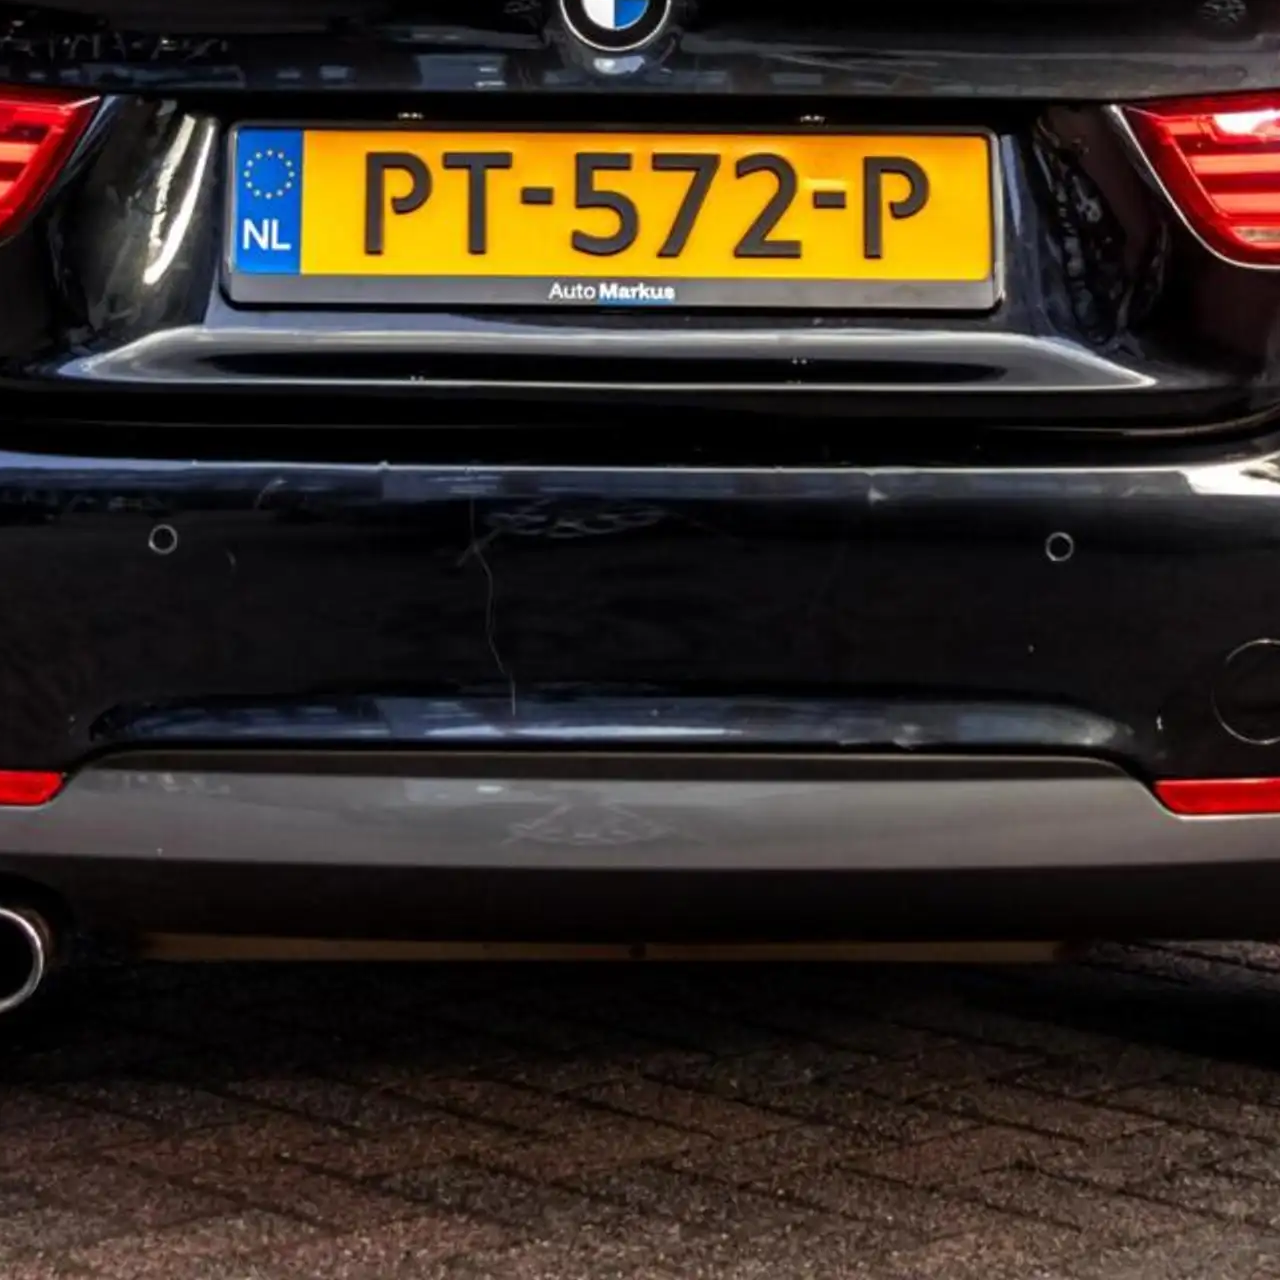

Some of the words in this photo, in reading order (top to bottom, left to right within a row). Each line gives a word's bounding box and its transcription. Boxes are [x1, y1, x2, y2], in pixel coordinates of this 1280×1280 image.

[364, 151, 930, 259] PT-572-P
[243, 219, 291, 251] NL
[548, 282, 596, 300] Auto
[599, 282, 675, 300] Markus
